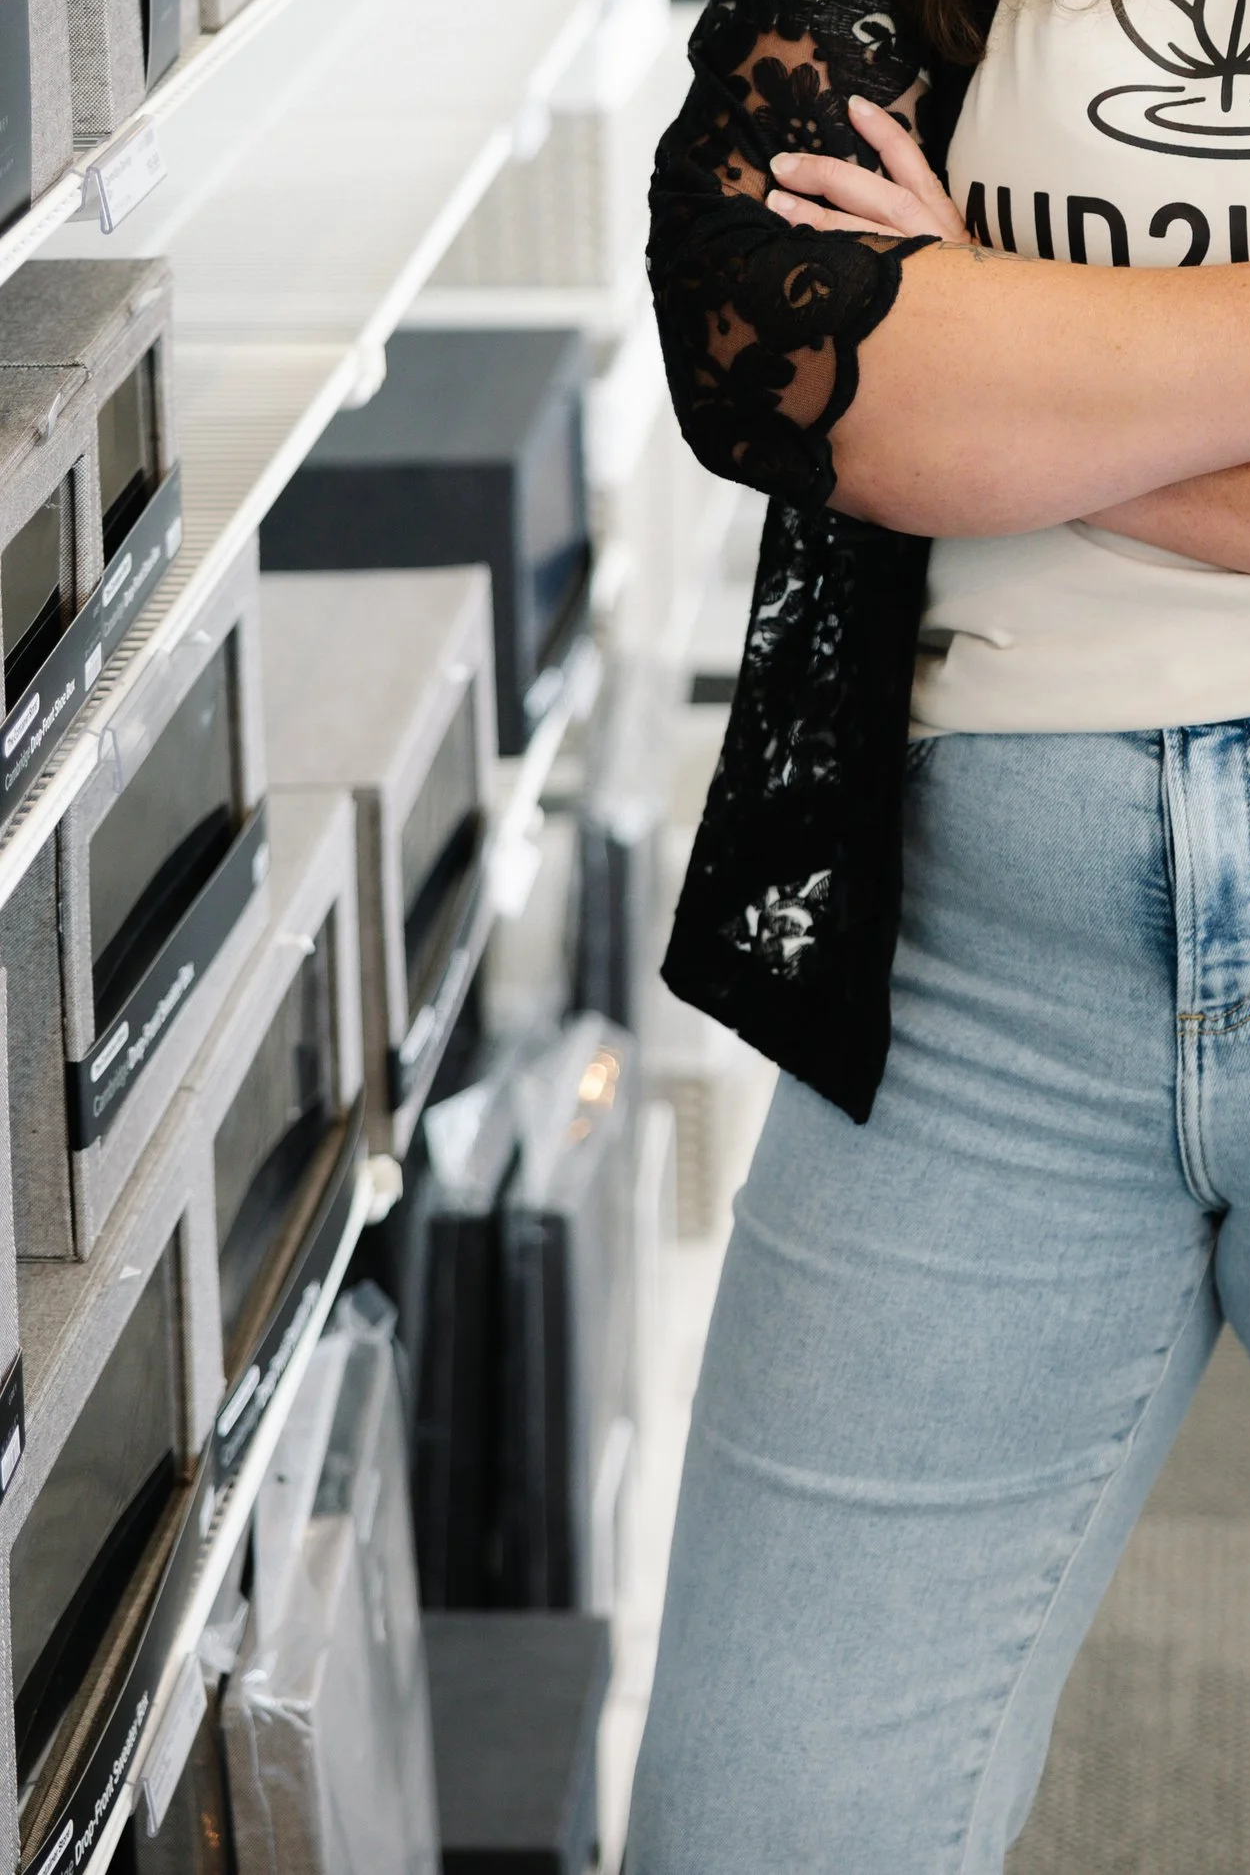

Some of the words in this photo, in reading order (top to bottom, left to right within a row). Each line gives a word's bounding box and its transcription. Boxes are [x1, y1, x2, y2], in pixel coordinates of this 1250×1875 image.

[5, 746, 31, 791] Cambridge
[31, 706, 55, 754] Drop-Front
[55, 693, 66, 718] Shoe
[66, 678, 75, 700] Box
[75, 1773, 115, 1866] Drop-Front
[113, 1717, 138, 1785] Sweater
